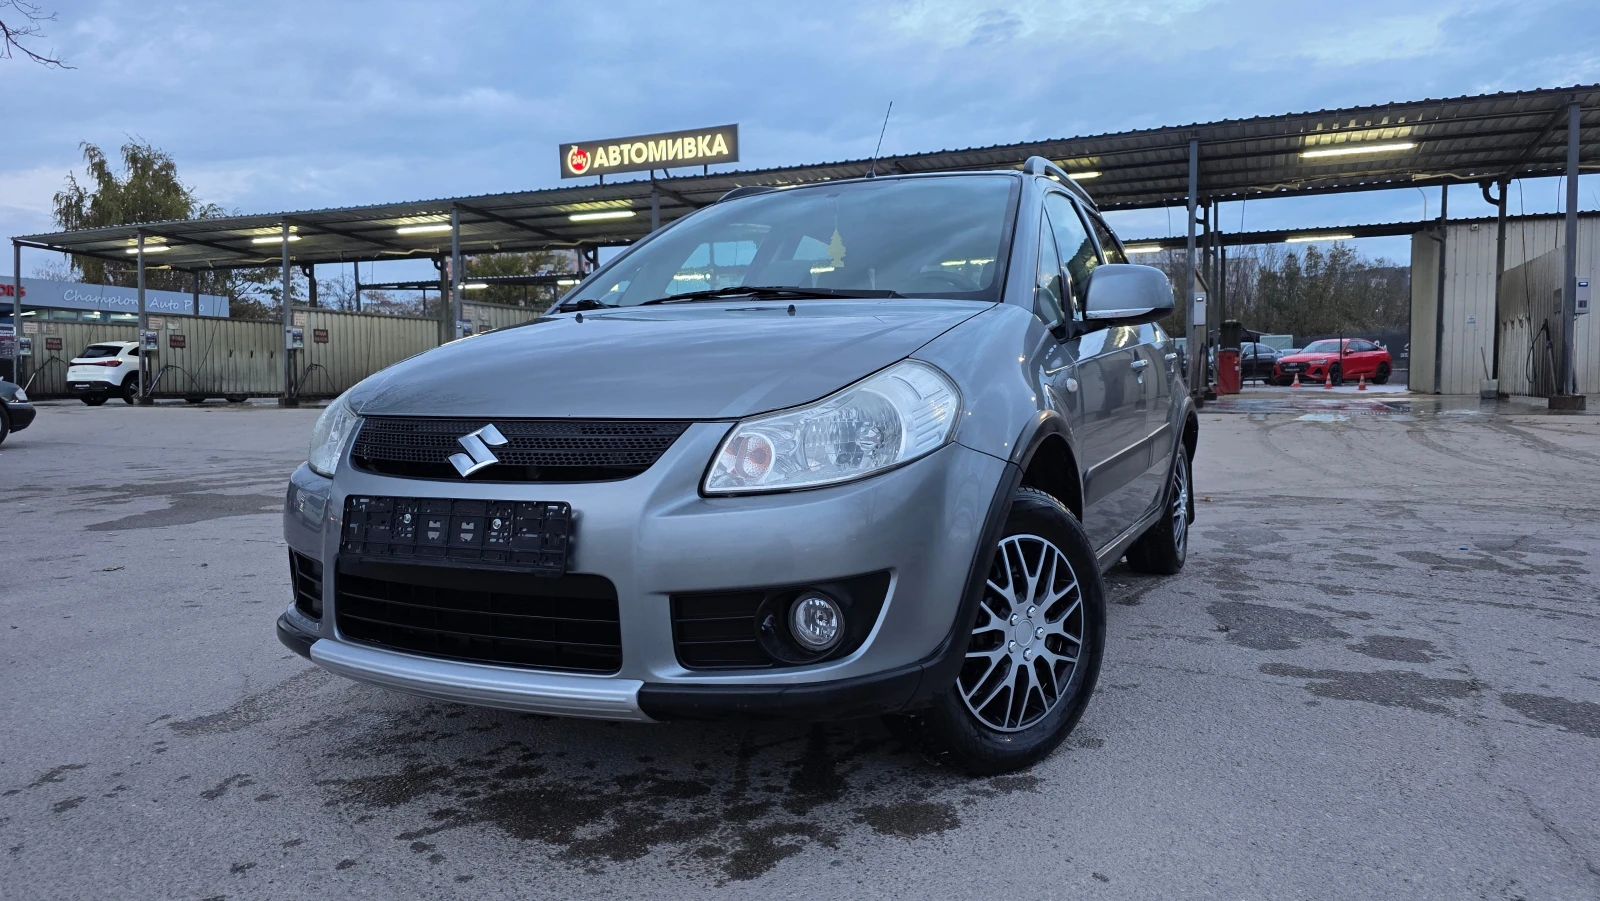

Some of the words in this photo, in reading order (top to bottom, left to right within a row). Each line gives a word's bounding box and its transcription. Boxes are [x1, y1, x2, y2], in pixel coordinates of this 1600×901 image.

[572, 155, 586, 166] 24/7
[593, 133, 729, 168] АВТОМИВКА
[63, 289, 139, 307] Champion
[149, 297, 180, 310] Auto
[184, 299, 205, 312] Po
